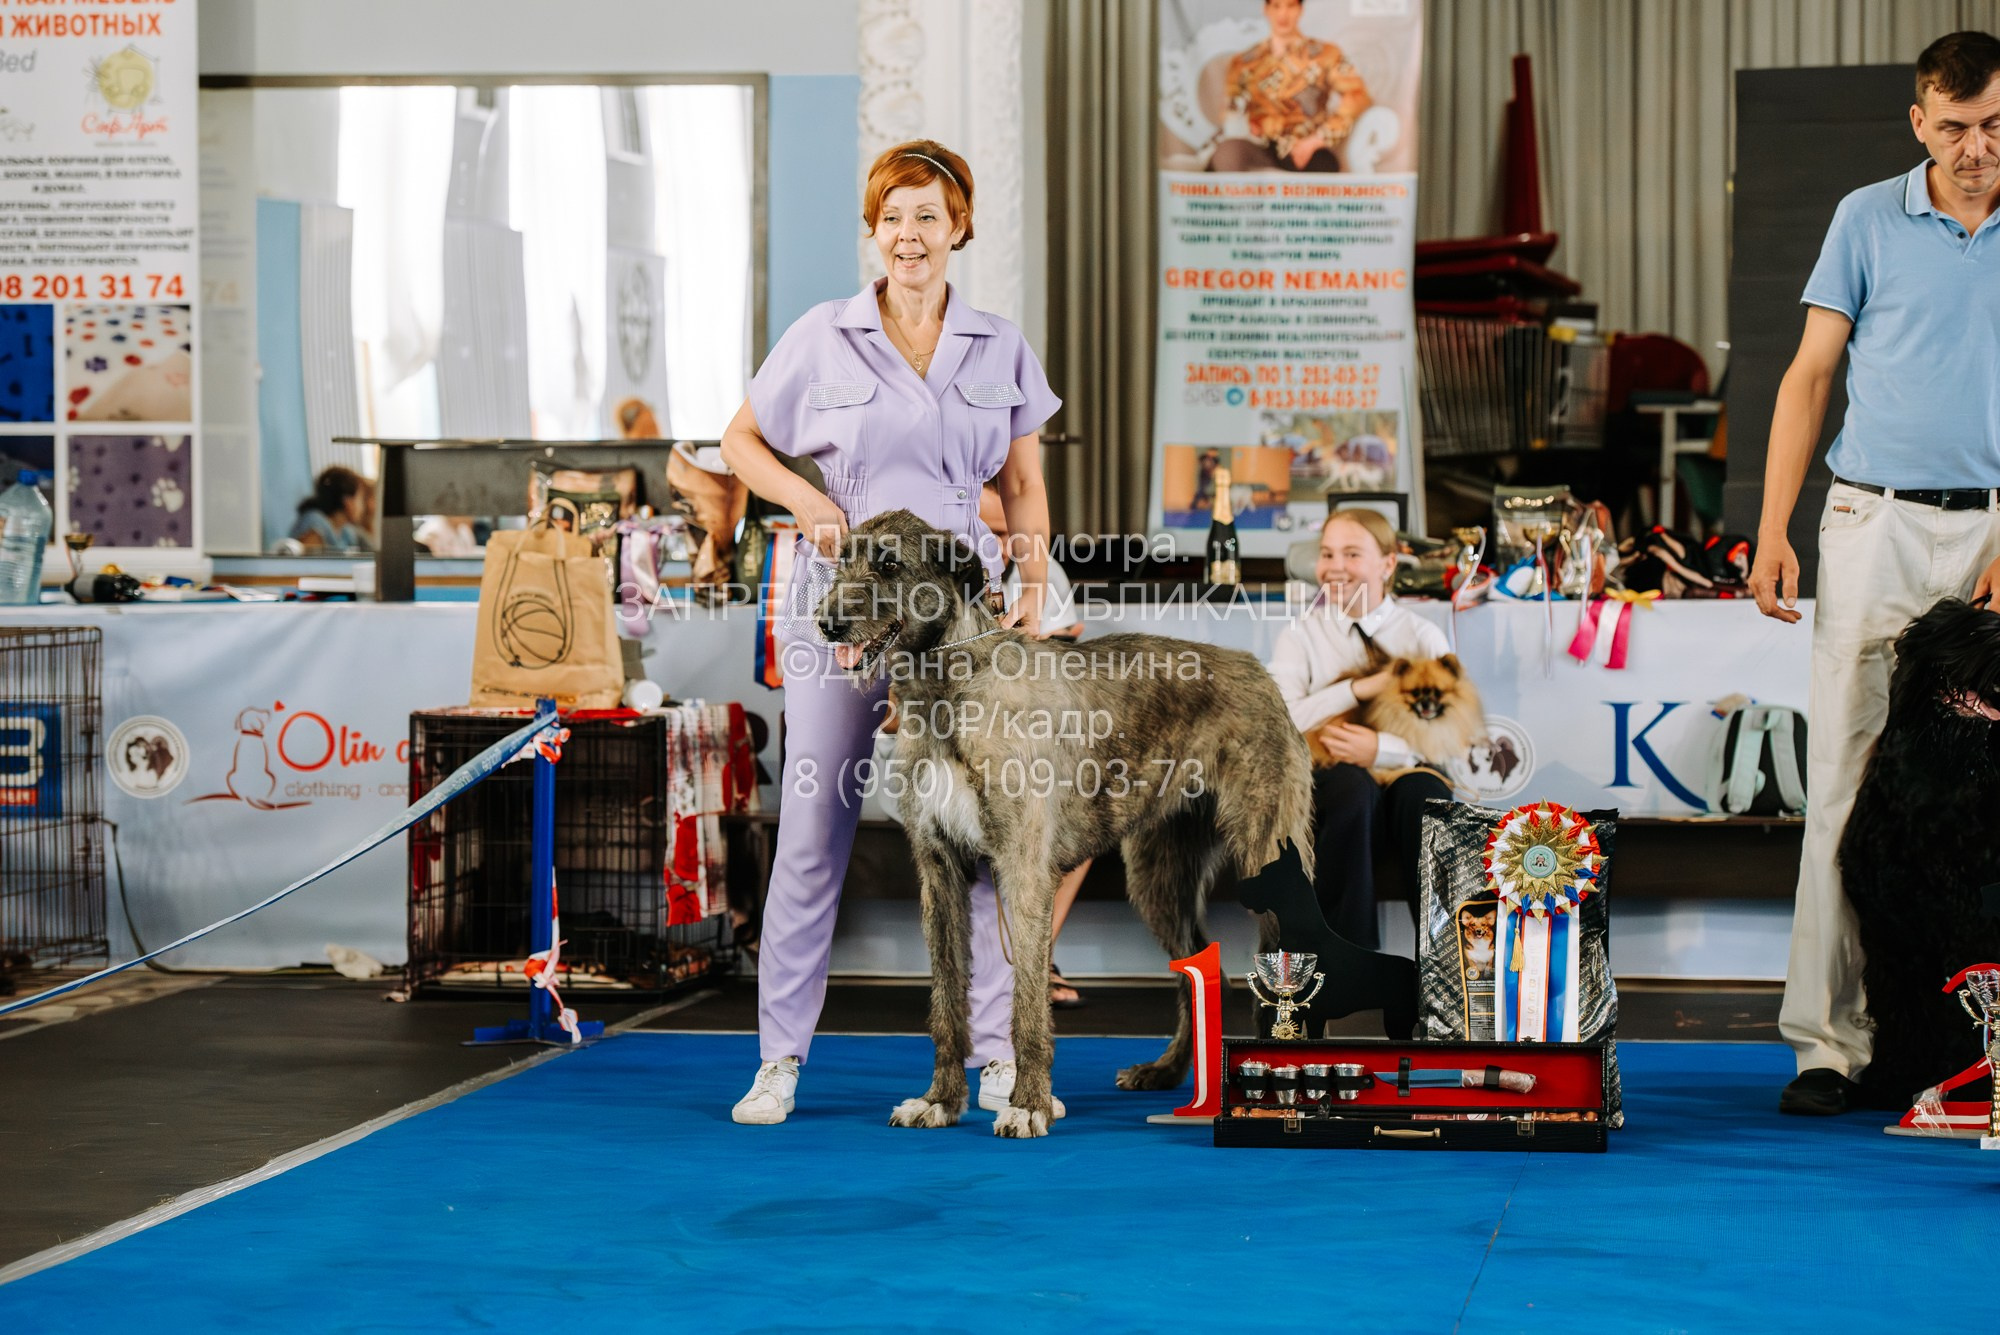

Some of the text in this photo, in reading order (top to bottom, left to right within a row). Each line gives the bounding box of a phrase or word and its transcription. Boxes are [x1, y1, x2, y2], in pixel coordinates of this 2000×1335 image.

[11, 13, 162, 38] ЖИВОТНЫХ
[0, 274, 184, 299] 8 201 31 74
[1165, 267, 1409, 290] GREGOR NEMANIC
[277, 710, 386, 772] Olin
[1600, 701, 1711, 812] K
[284, 781, 362, 800] clothing
[1169, 941, 1222, 1117] 1
